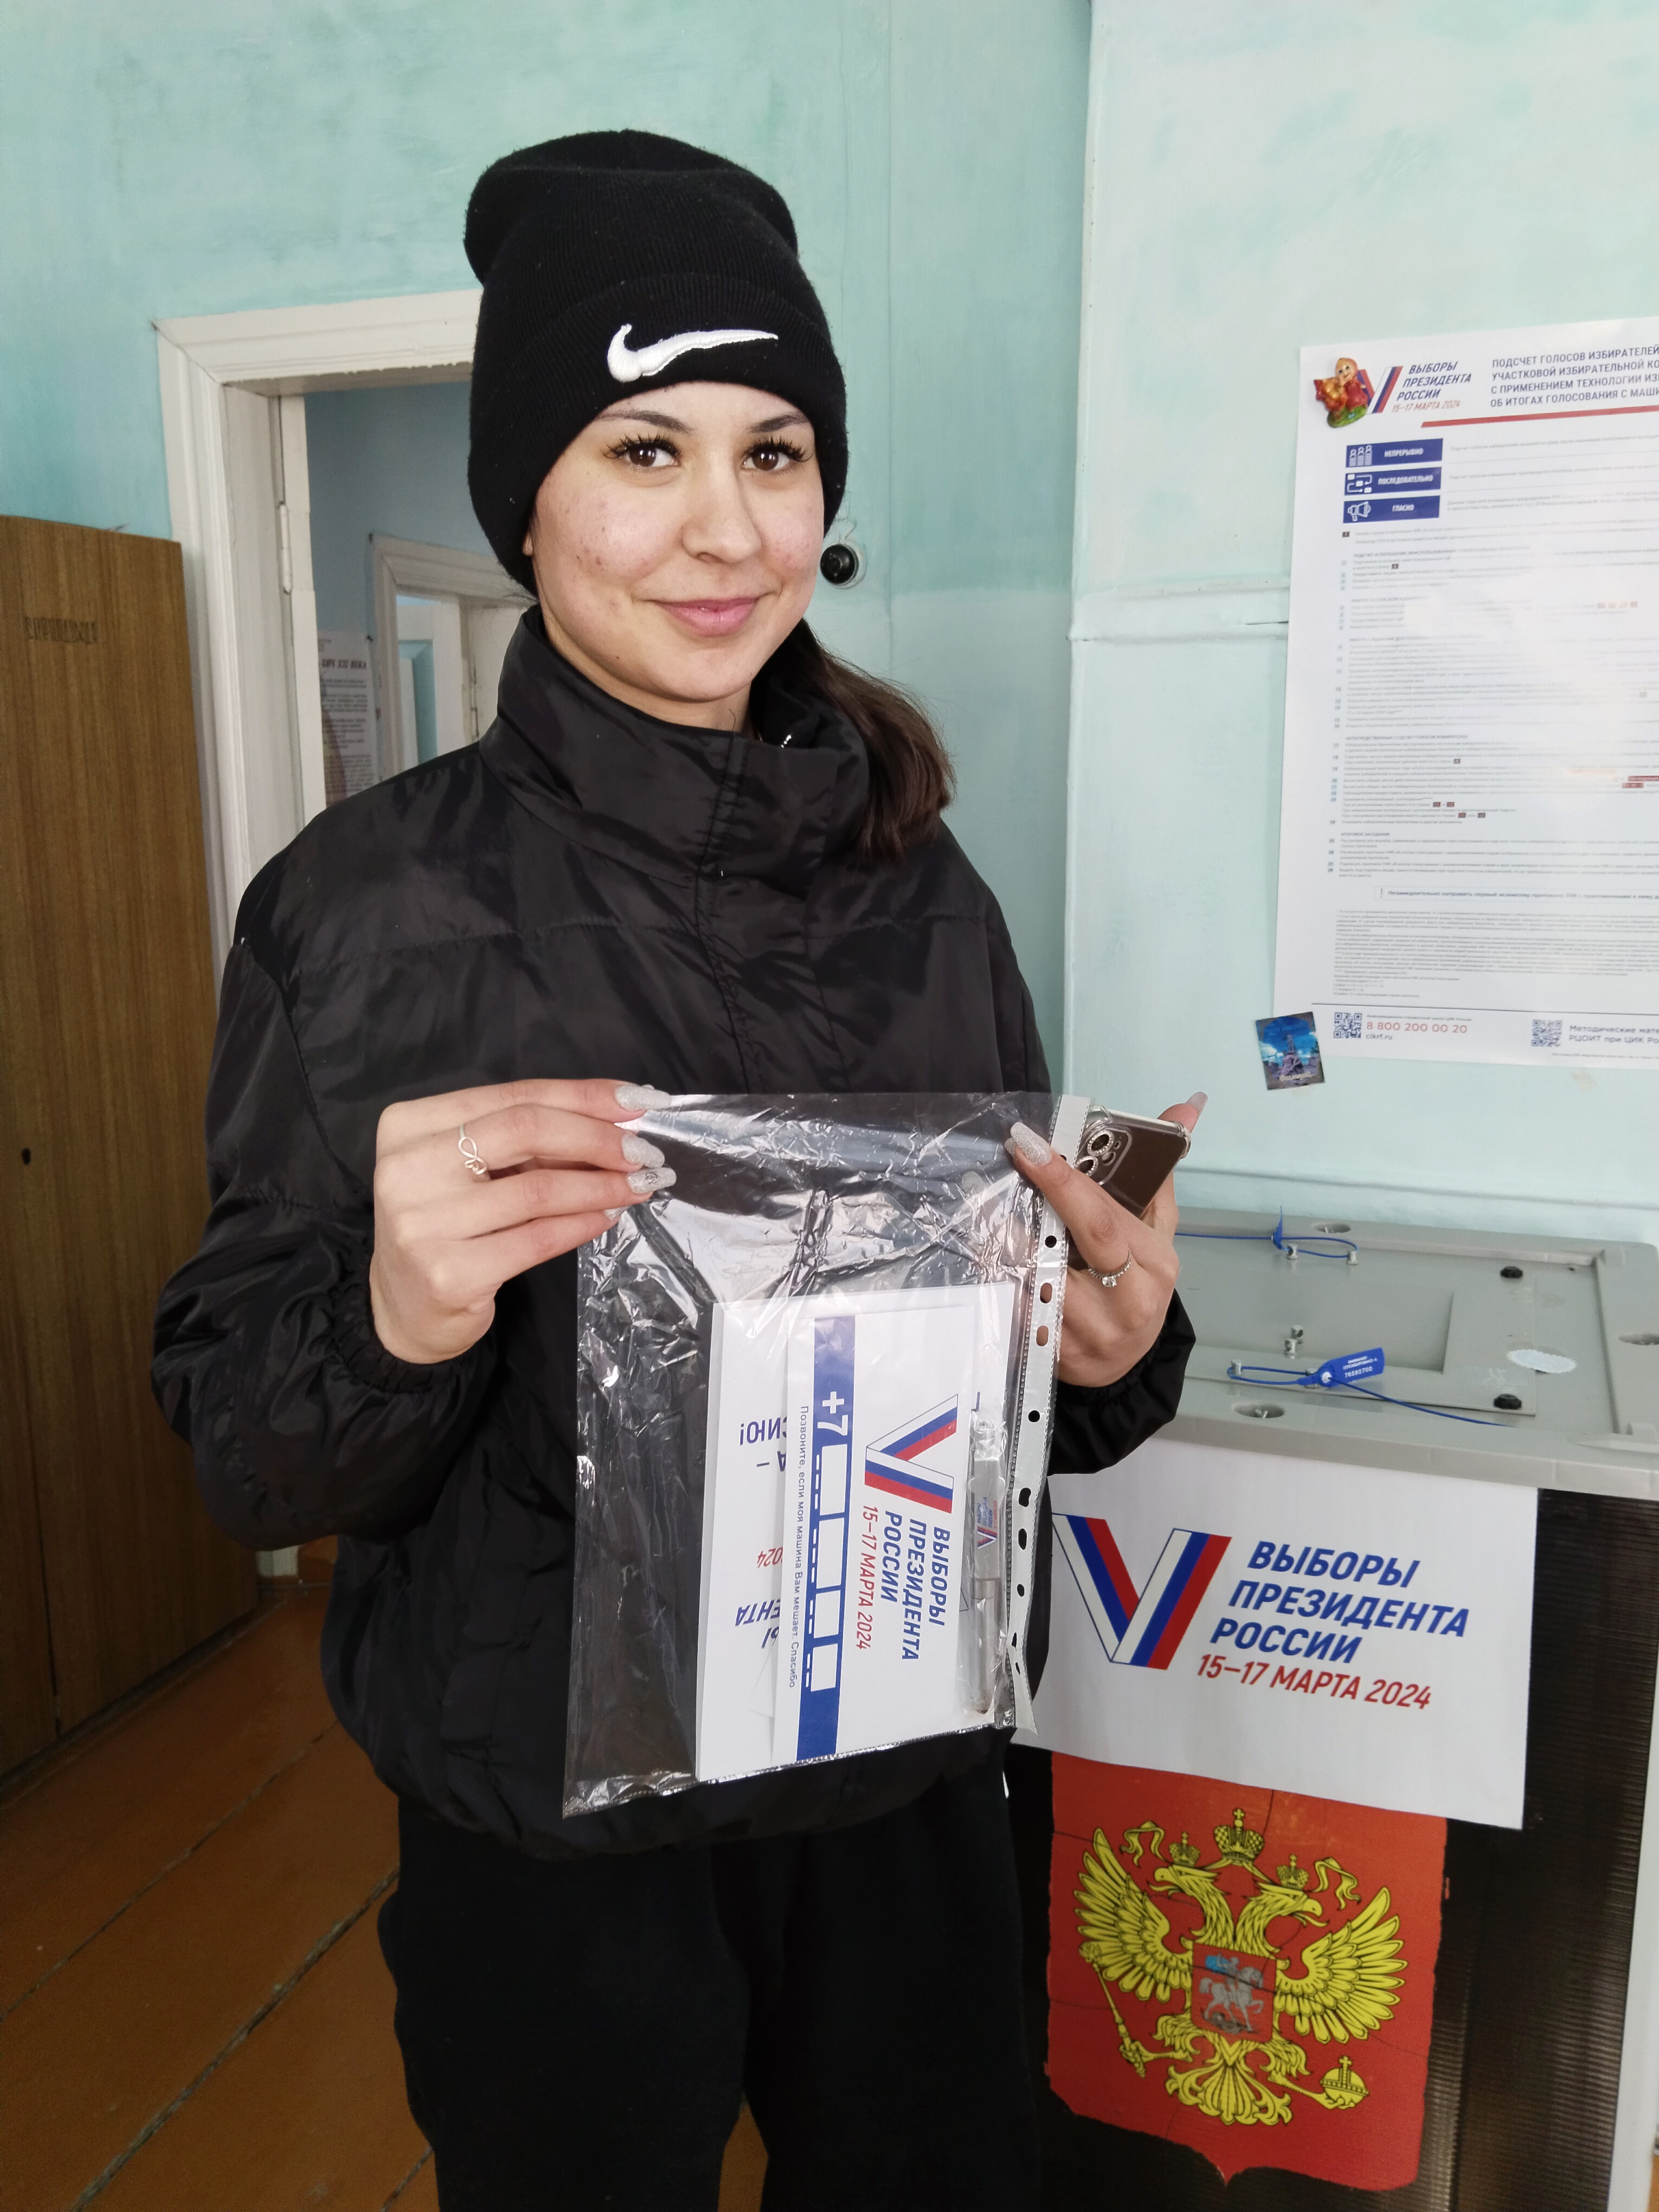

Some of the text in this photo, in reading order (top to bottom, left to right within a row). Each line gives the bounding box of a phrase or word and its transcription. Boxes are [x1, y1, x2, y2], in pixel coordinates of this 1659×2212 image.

[1409, 361, 1458, 375] ВЫБОРЫ
[1492, 344, 1659, 368] ПОДСЧЕТ ГОЛОСОВ ИЗБИРАТЕЛЕЙ
[1492, 366, 1556, 381] УЧАСТКОВОЙ
[1559, 359, 1644, 375] ИЗБИРАТЕЛЬНОЙ
[1397, 389, 1441, 401] РОССИИ
[1403, 374, 1471, 388] ПРЕЗИДЕНТА
[1490, 398, 1503, 407] ОБ
[1506, 396, 1542, 406] ИТОГАХ
[1546, 390, 1618, 403] ГОЛОСОВАНИЯ
[1491, 374, 1659, 394] С ПРИМЕНЕНИЕМ ТЕХНОЛОГИИ ИЗ
[1414, 401, 1441, 411] МАРТА
[1441, 400, 1461, 409] 2024
[1385, 448, 1424, 458] НЕПРЕРЫВНО
[1366, 1021, 1468, 1033] 8 800 200 00 20
[817, 1391, 848, 1436] +7
[799, 1406, 809, 1468] Позвоните,
[880, 1510, 902, 1603] РОССИИ
[928, 1526, 950, 1626] ВЫБОРЫ
[1247, 1540, 1420, 1588] ВЫБОРЫ
[794, 1572, 803, 1594] Вам
[858, 1552, 876, 1607] МАРТА
[902, 1519, 927, 1660] ПРЕЗИДЕНТА
[1228, 1579, 1469, 1637] ПРЕЗИДЕНТА
[856, 1611, 873, 1650] 2024
[1210, 1617, 1363, 1664] РОССИИ
[789, 1642, 799, 1688] Спасибо
[1270, 1665, 1360, 1700] МАРТА
[1364, 1679, 1431, 1709] 2024
